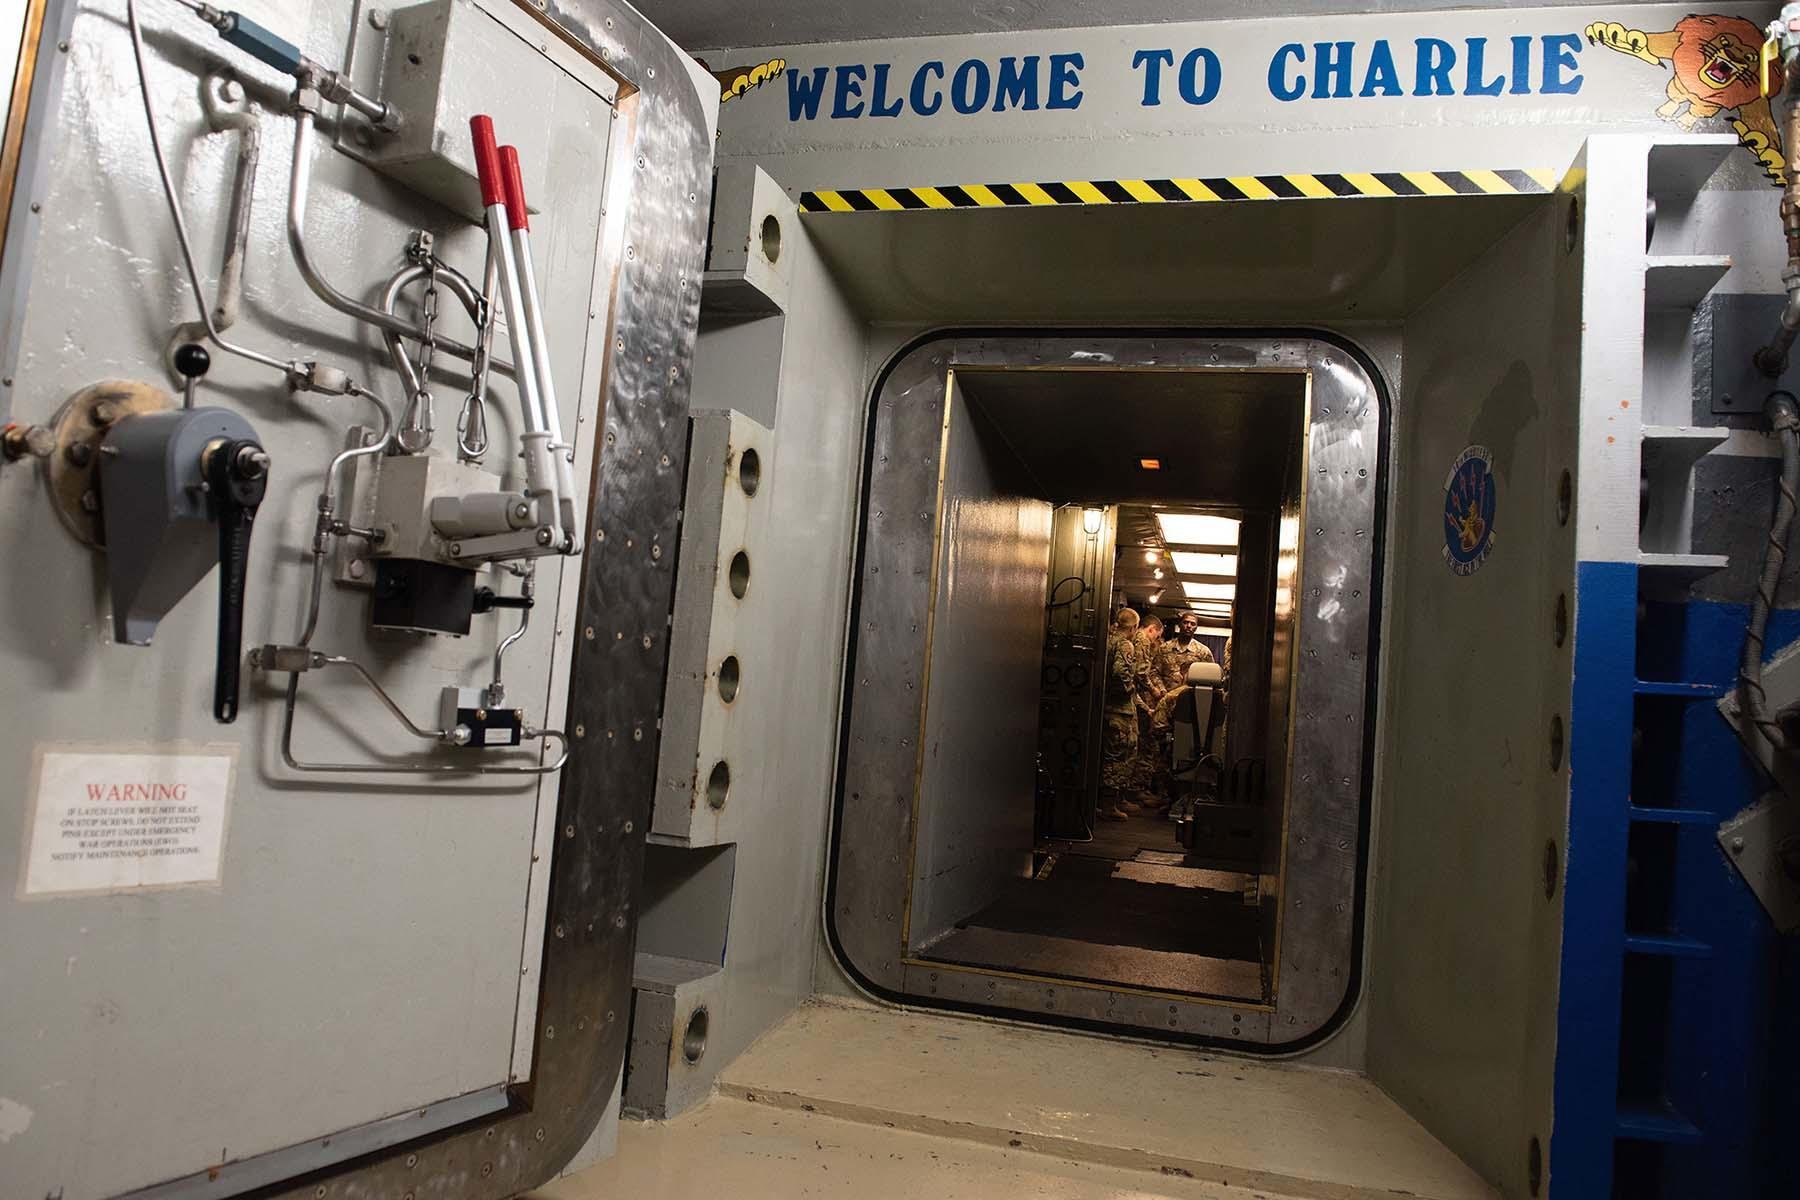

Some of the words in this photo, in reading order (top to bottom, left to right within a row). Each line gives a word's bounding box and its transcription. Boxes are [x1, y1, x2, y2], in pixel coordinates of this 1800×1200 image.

[786, 52, 1084, 121] WELCOME
[1132, 48, 1222, 106] TO
[1267, 33, 1584, 102] CHARLIE
[86, 784, 187, 800] WARNING
[150, 816, 168, 825] NOT
[168, 815, 200, 824] EXTEND
[83, 828, 117, 838] EXCEPT
[118, 827, 146, 837] UNDER
[148, 825, 196, 835] EMERGENCY
[51, 851, 84, 861] NOTIFY
